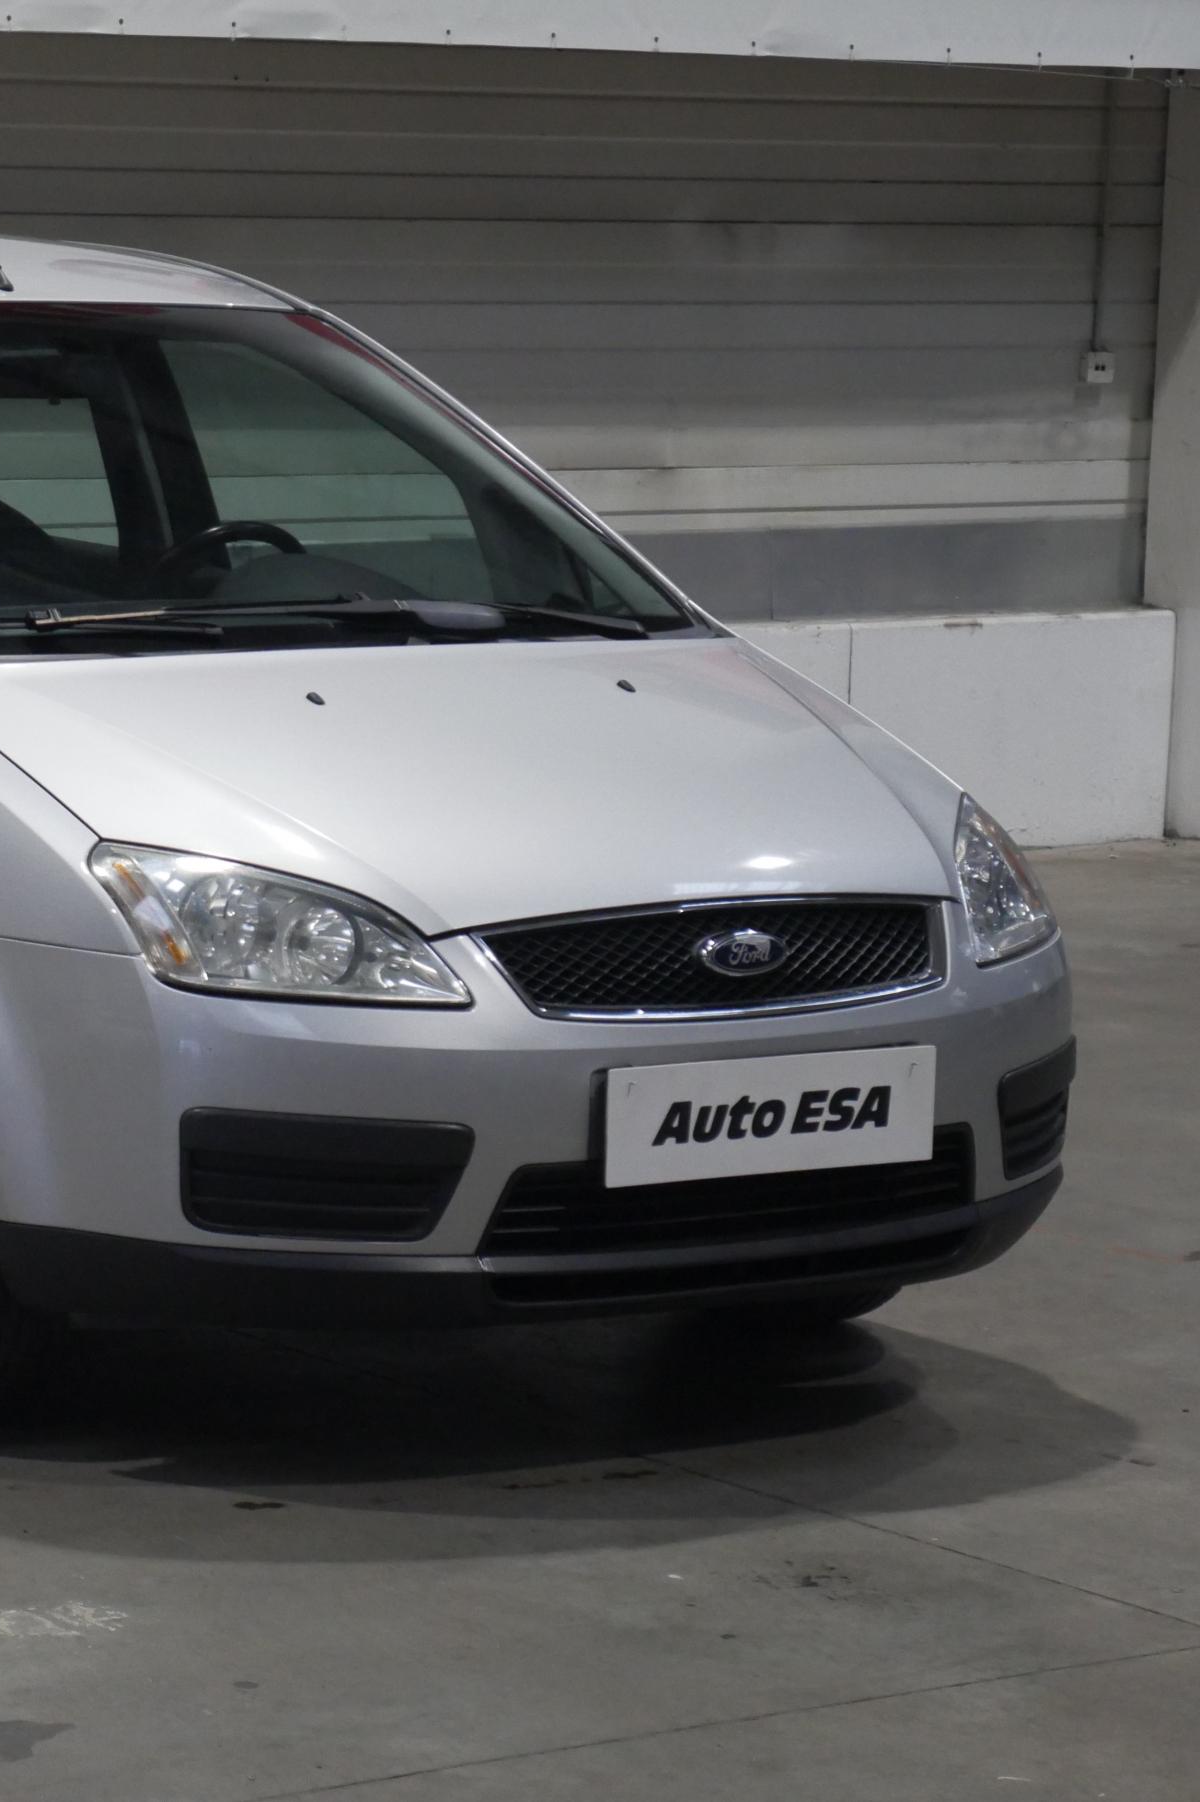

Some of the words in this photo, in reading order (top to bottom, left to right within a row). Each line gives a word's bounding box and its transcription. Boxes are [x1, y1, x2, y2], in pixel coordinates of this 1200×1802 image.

[728, 940, 770, 966] Ford
[651, 1095, 786, 1147] Auto
[790, 1085, 892, 1134] ESA
